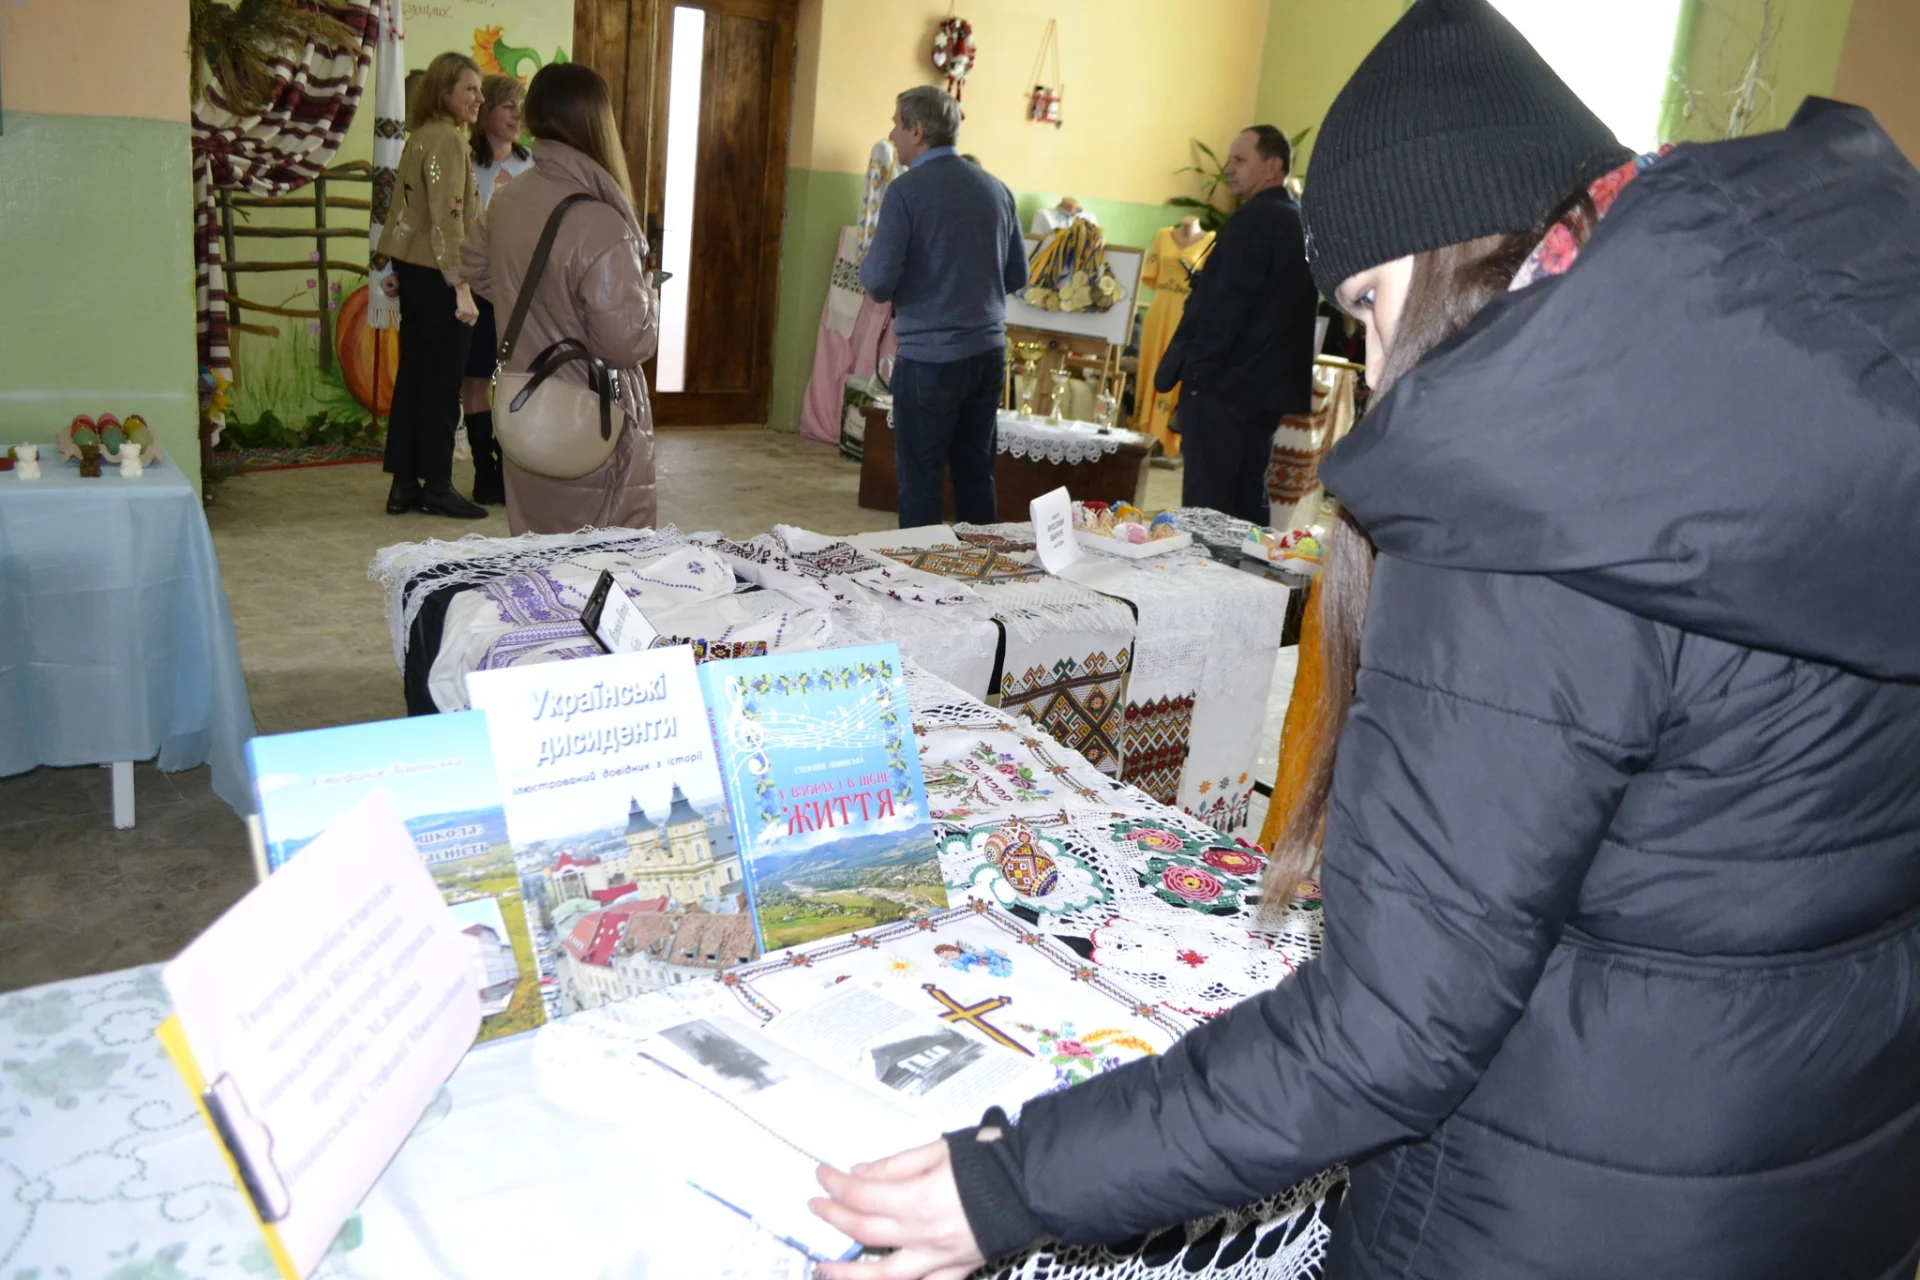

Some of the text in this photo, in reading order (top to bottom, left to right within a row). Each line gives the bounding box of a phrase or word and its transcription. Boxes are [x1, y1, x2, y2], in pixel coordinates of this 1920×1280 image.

[532, 672, 667, 722] Українські
[536, 716, 677, 767] дисиденти
[513, 751, 703, 795] ілюстрований довідник з історії
[779, 772, 889, 800] У ВЗОРАХ І В ПІСНІ
[418, 825, 483, 845] школа:
[782, 788, 896, 836] ЖИТТЯ
